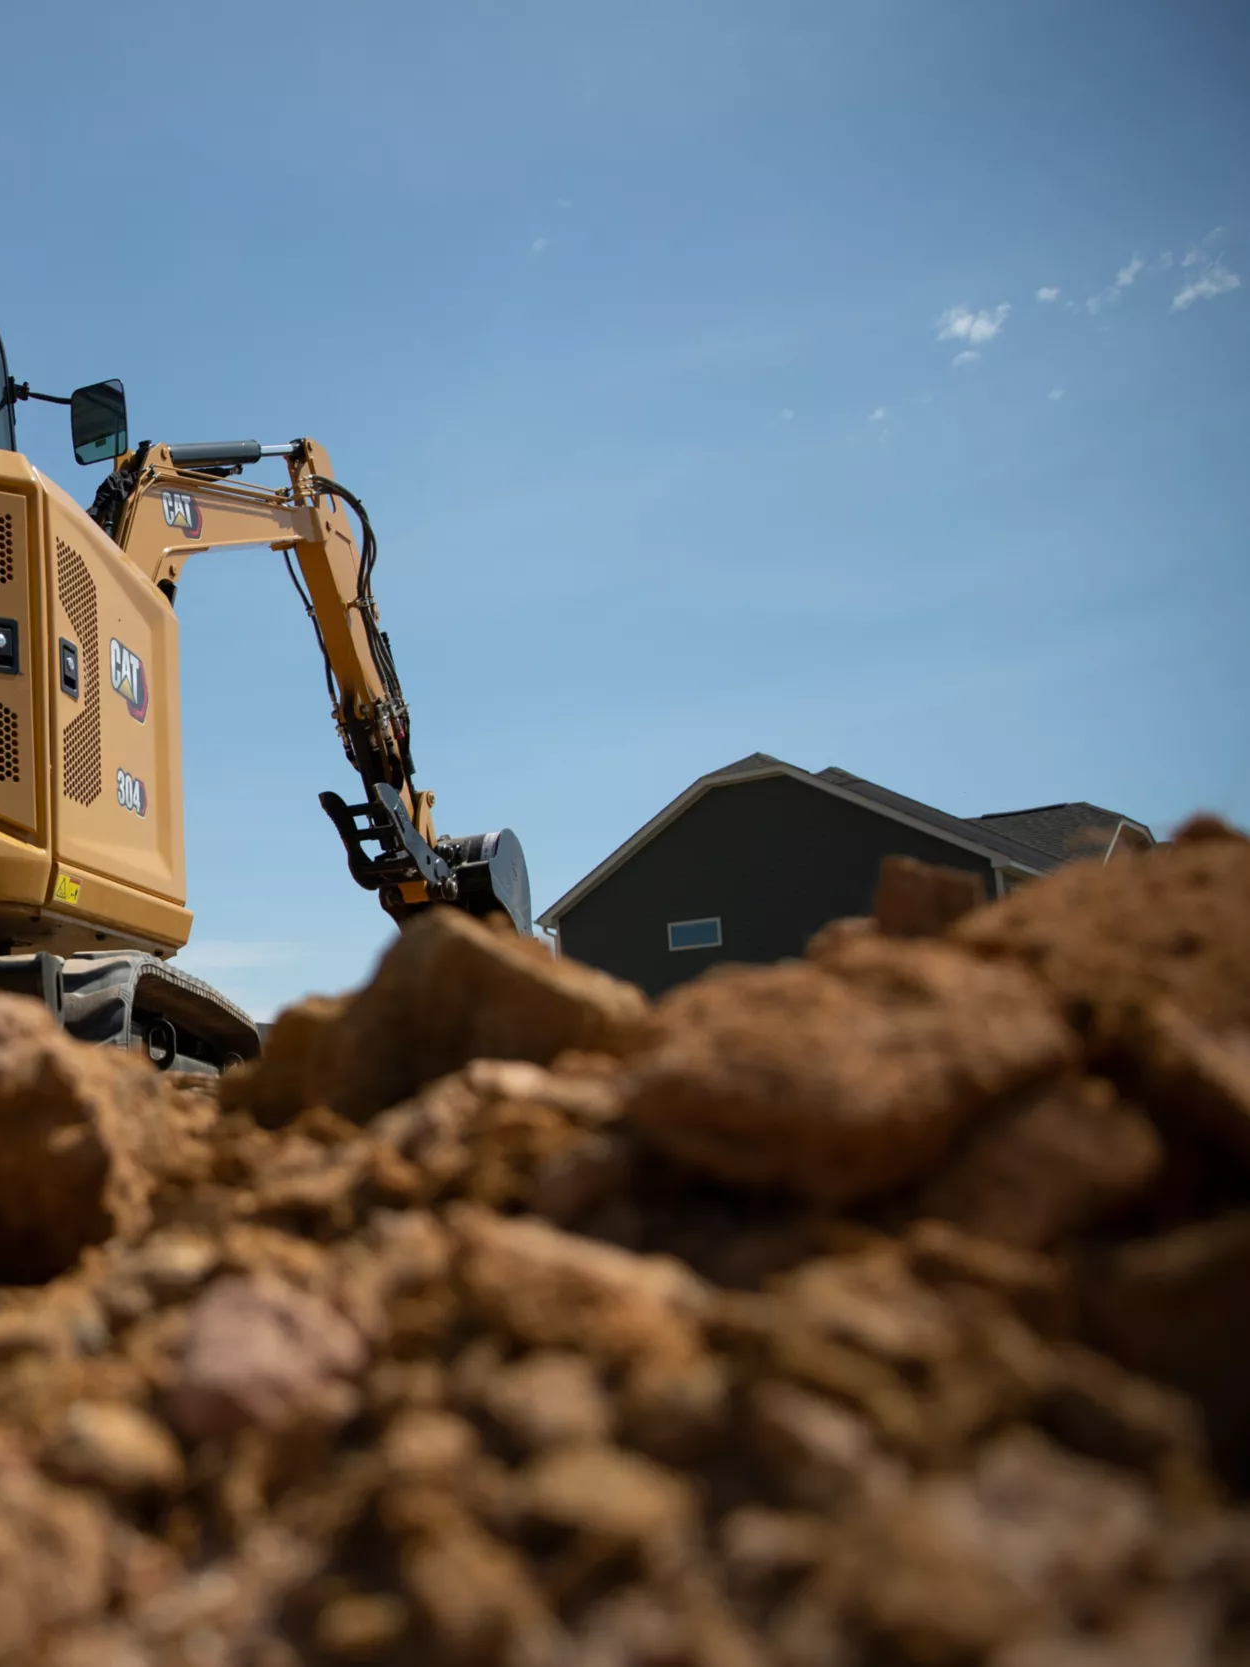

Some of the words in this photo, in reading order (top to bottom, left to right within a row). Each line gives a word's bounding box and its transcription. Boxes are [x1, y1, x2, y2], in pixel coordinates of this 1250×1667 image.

[162, 489, 195, 531] CAT
[110, 637, 141, 704] CAT
[118, 771, 140, 812] 304
